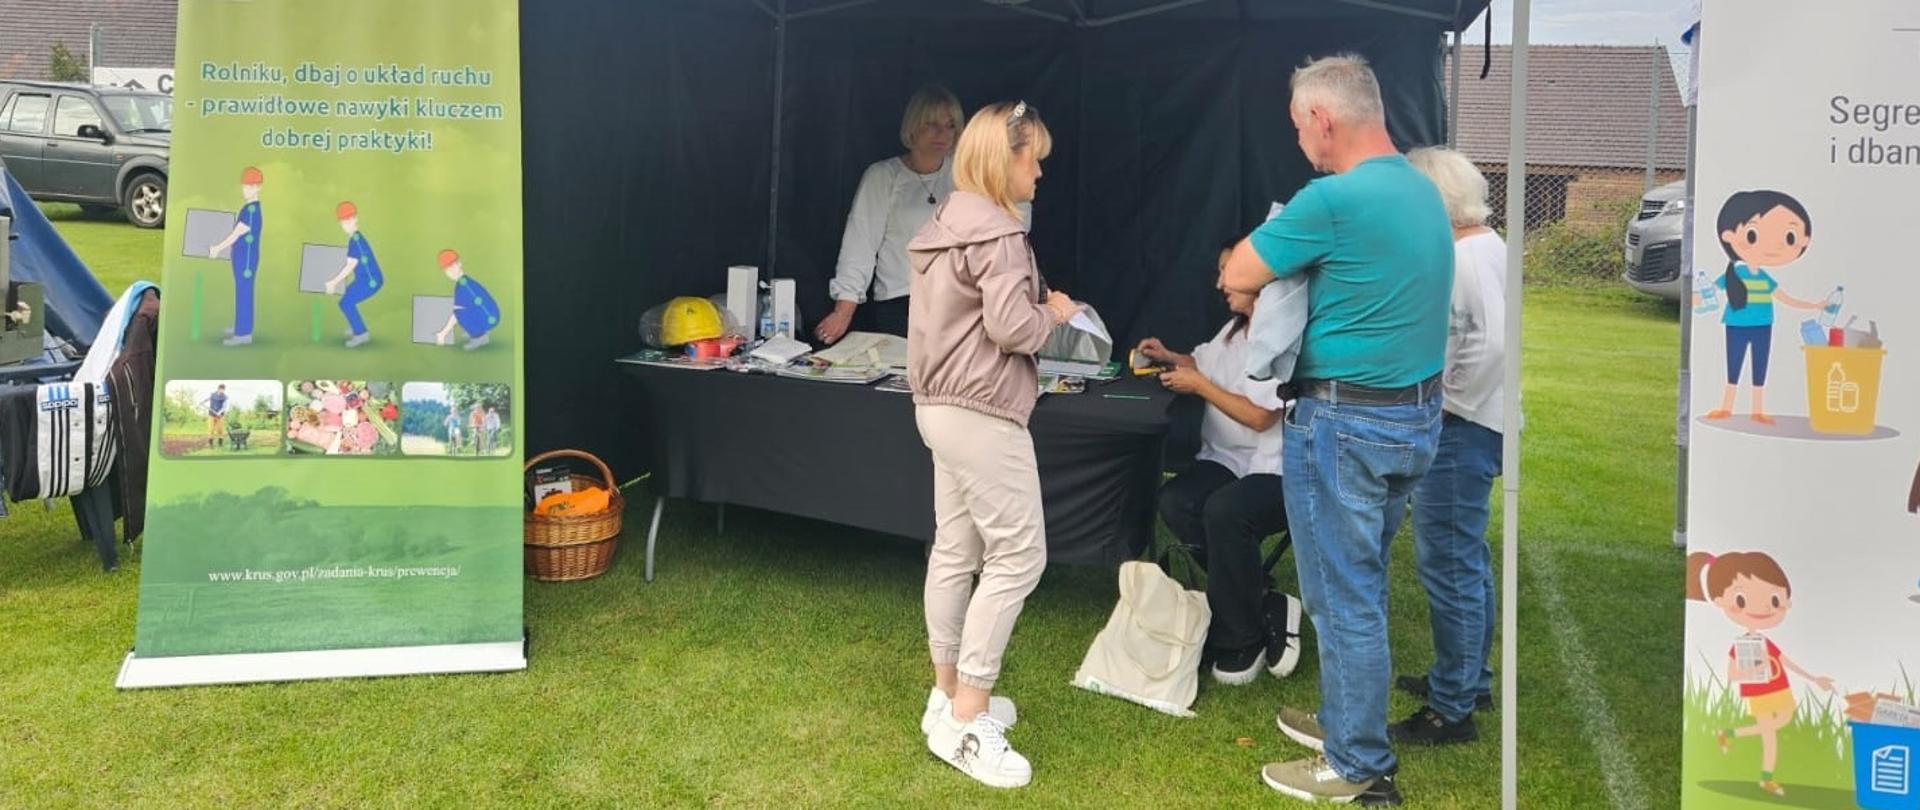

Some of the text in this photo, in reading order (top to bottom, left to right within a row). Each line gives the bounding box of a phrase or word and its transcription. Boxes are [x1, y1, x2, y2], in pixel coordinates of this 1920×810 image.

[201, 63, 491, 87] Rolniku, dbaj o układ ruchu
[202, 98, 329, 116] prawidłowe
[336, 101, 409, 120] nawyki
[416, 102, 503, 119] kluczem
[1830, 95, 1920, 131] Segre
[262, 129, 433, 152] dobrej praktyki!
[1831, 136, 1920, 165] i dban
